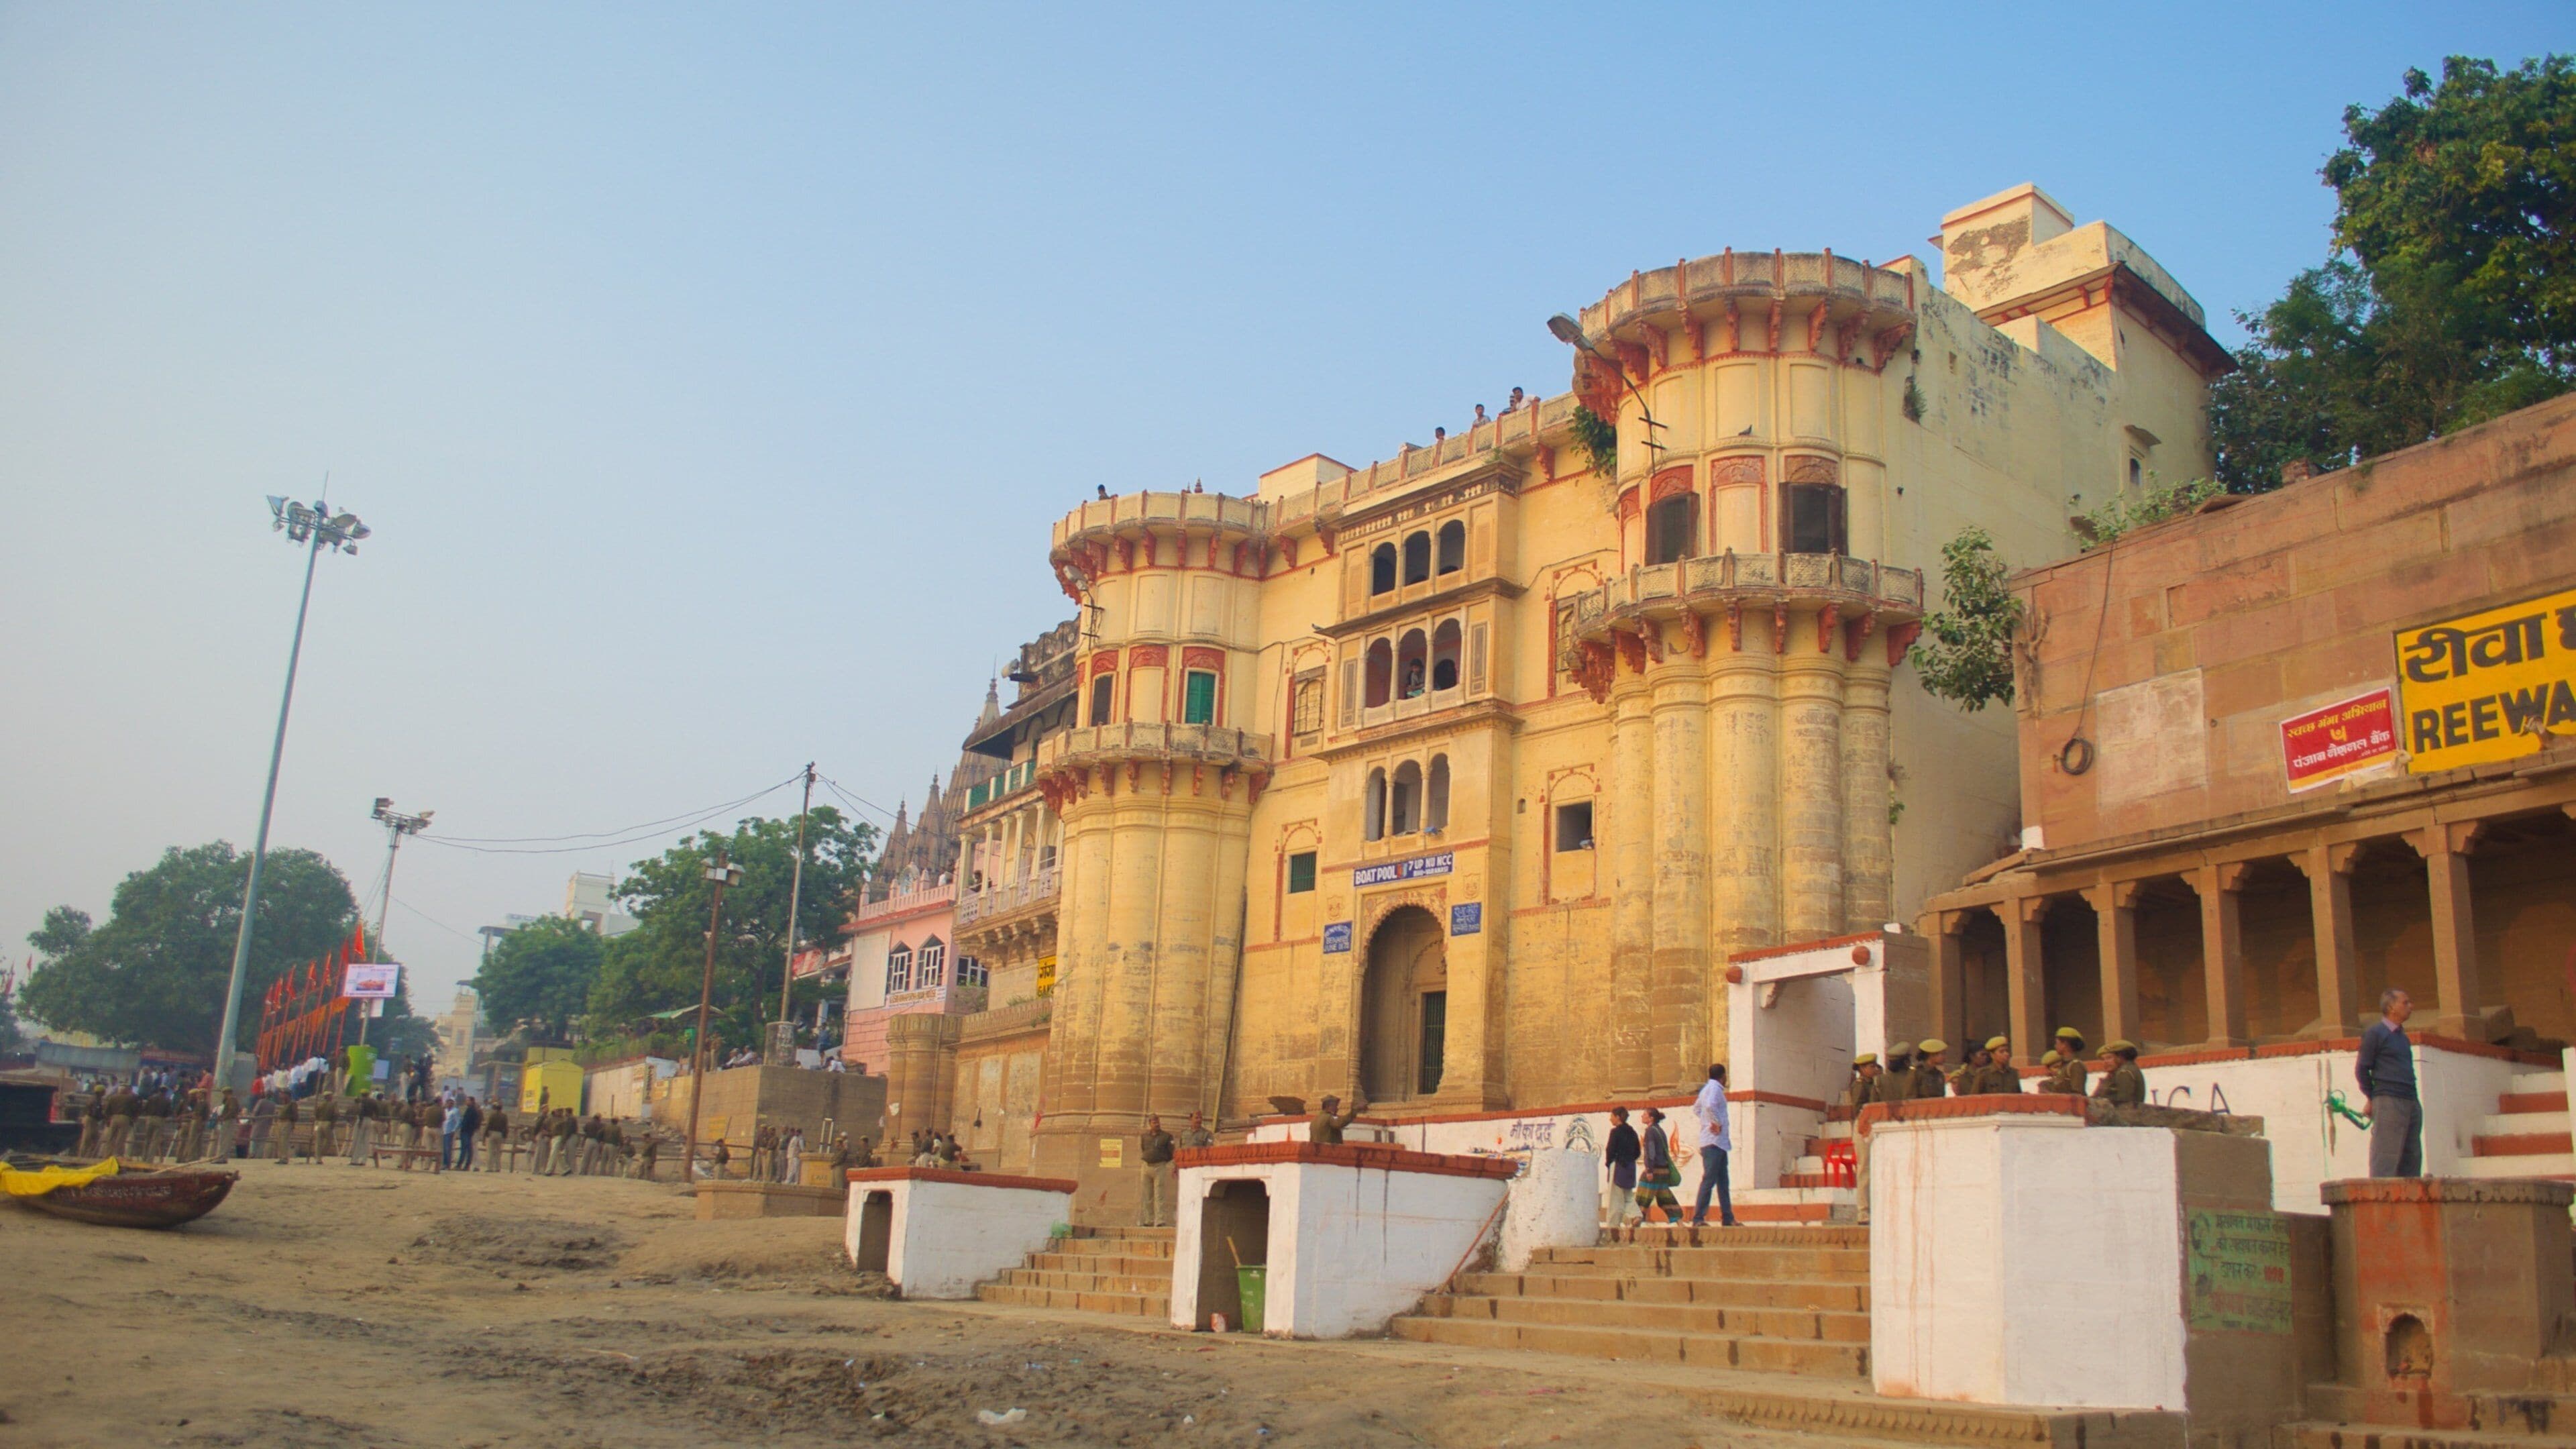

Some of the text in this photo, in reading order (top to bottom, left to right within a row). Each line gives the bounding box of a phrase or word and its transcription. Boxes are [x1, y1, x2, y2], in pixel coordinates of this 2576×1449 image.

[2404, 612, 2547, 683] रीवा
[2288, 699, 2387, 738] स्वच्छ गंगा अभियान
[2293, 751, 2326, 768] पंजाब
[1409, 861, 1413, 870] 7
[1414, 859, 1424, 869] UP
[1437, 855, 1452, 866] NCC
[1355, 865, 1397, 885] BOAT POOL
